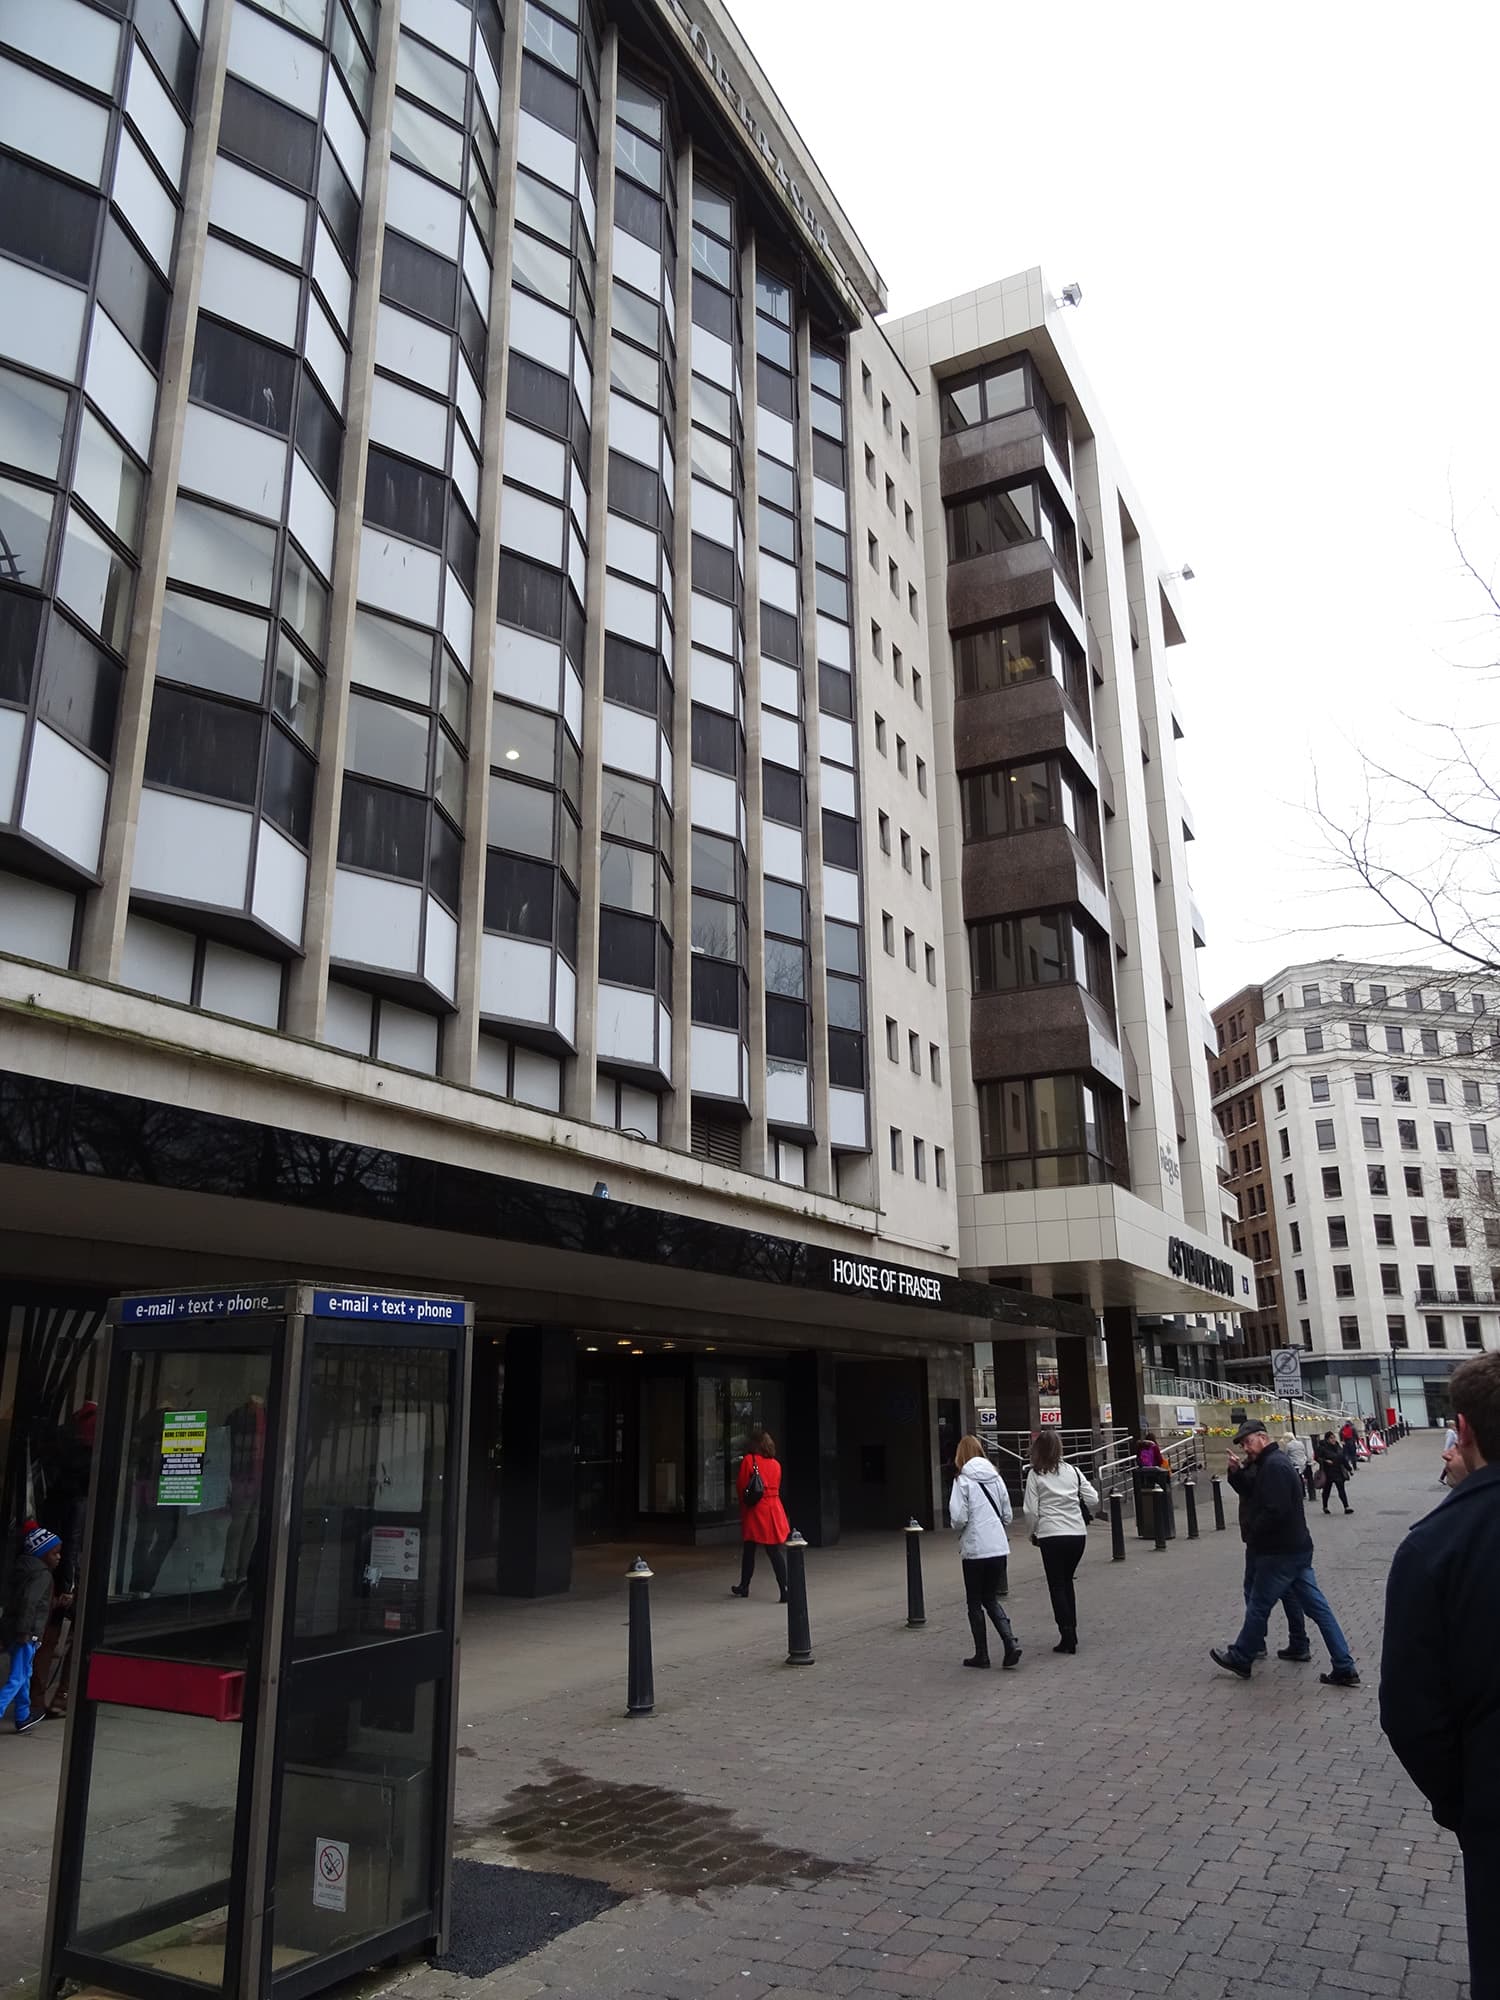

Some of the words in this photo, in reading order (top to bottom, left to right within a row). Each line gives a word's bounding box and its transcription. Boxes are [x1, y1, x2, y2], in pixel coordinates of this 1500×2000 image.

[832, 1258, 879, 1290] HOUSE
[879, 1268, 897, 1292] OF
[898, 1272, 942, 1302] FRASER
[135, 1299, 175, 1318] e-mail
[187, 1299, 214, 1315] text
[227, 1293, 269, 1315] phone
[328, 1296, 369, 1313] e-mail
[381, 1300, 406, 1316] text
[417, 1303, 453, 1320] phone
